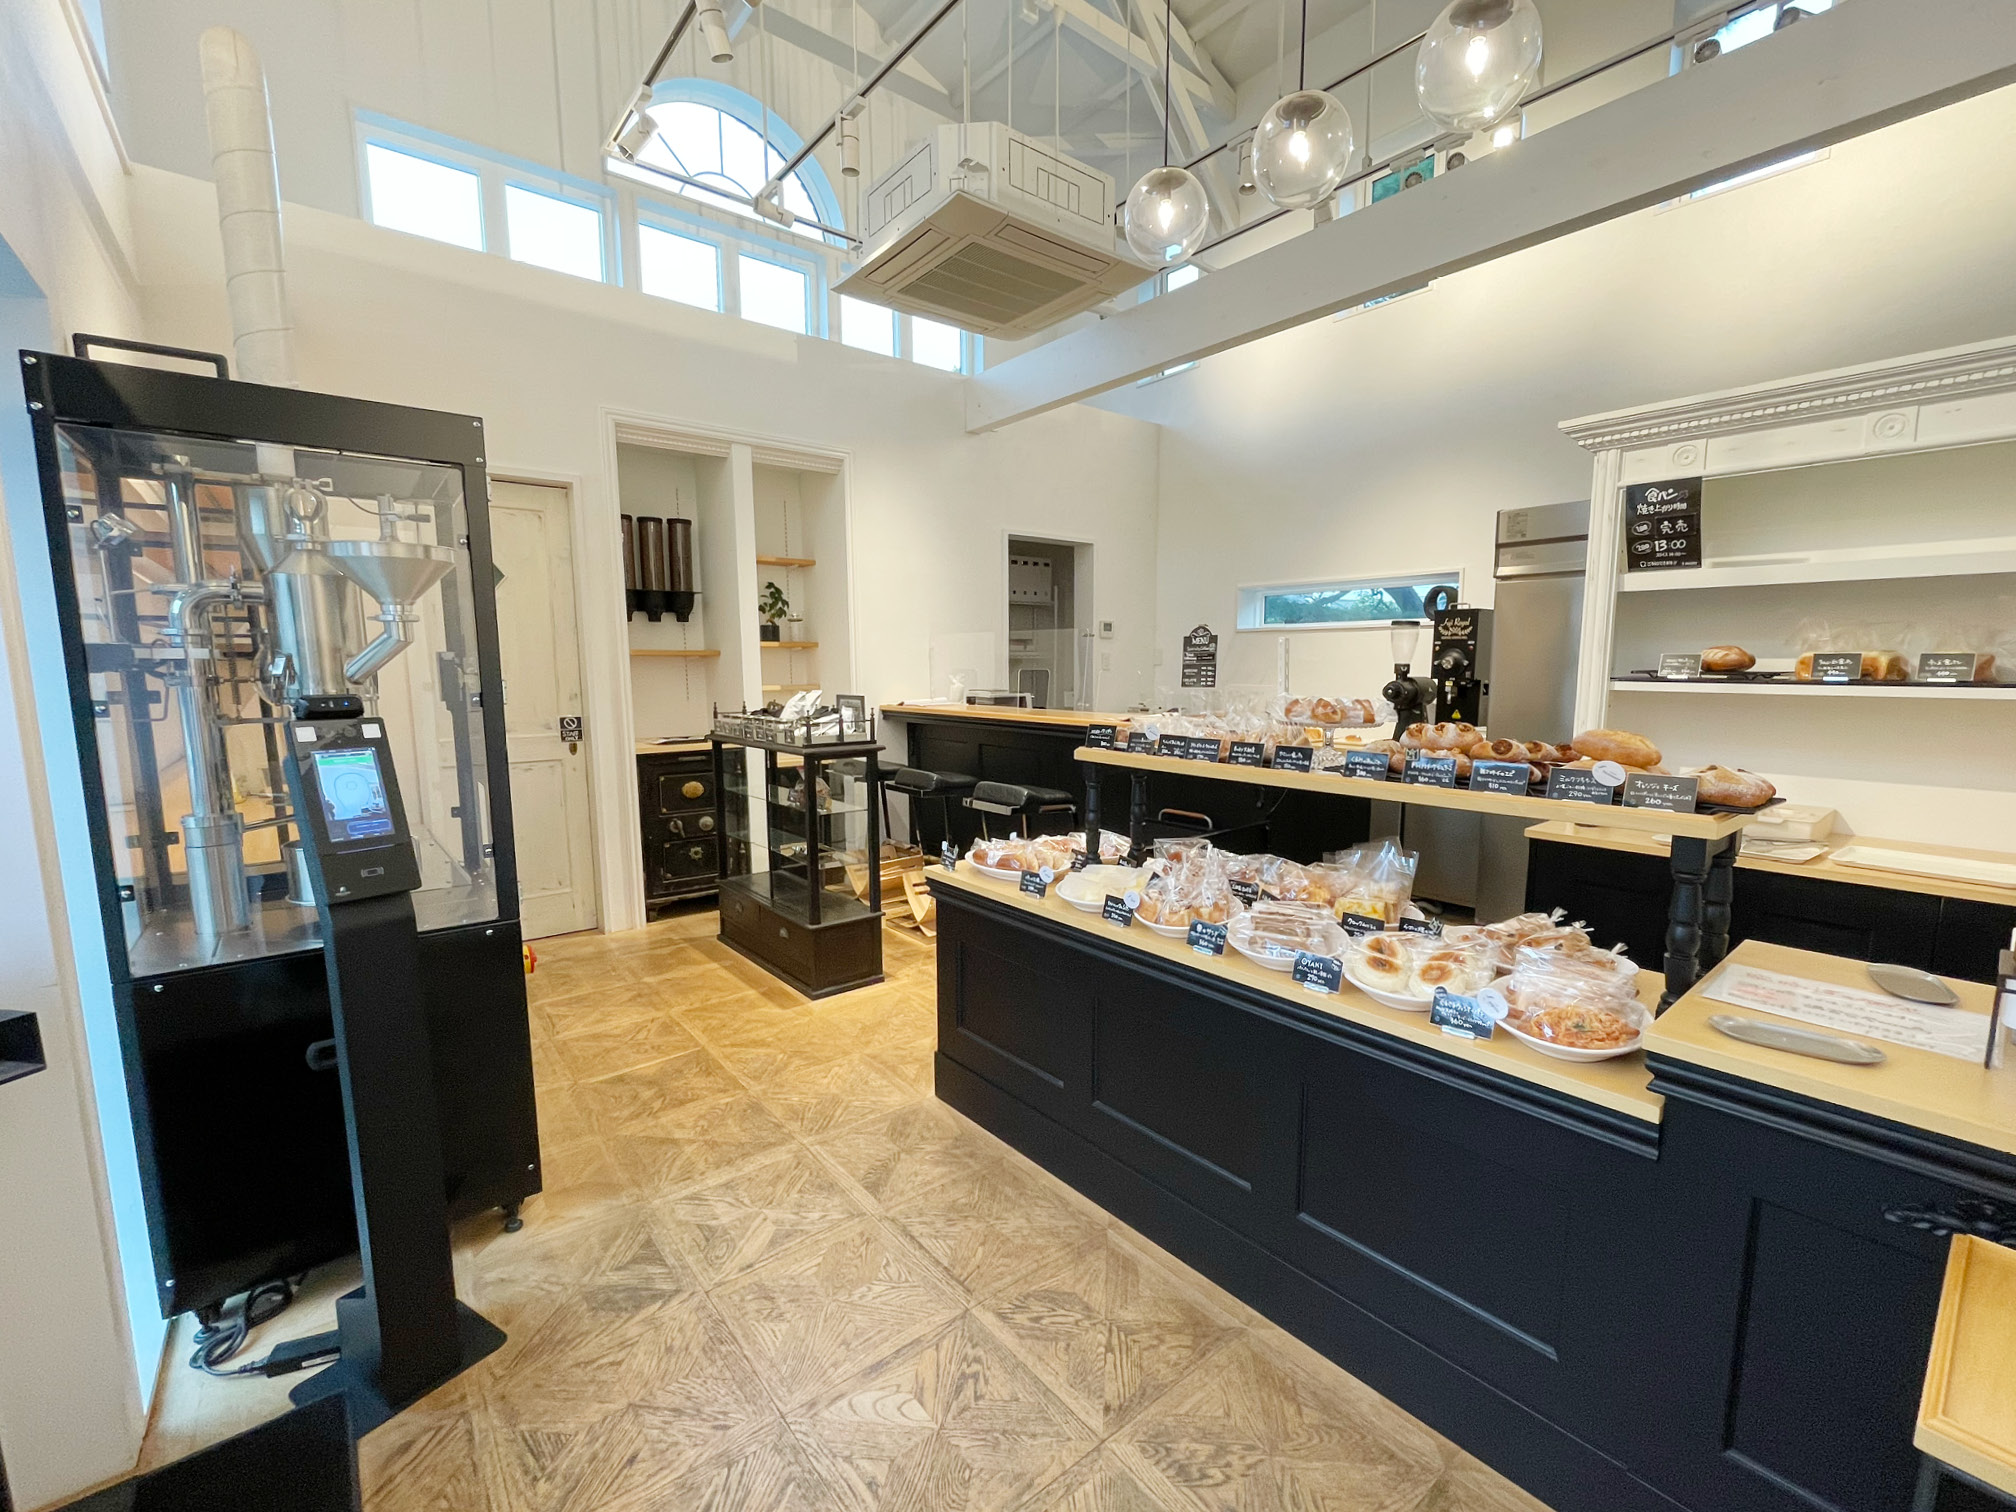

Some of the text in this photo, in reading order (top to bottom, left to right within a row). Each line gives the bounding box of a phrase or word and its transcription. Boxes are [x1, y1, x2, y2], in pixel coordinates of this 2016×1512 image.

[1645, 487, 1678, 502] 食パン
[1654, 539, 1686, 551] 13:00
[1454, 616, 1471, 627] Royal
[1191, 636, 1209, 645] MENU
[1645, 797, 1662, 805] 260
[1301, 957, 1323, 970] OYAKI
[1307, 973, 1318, 982] 290
